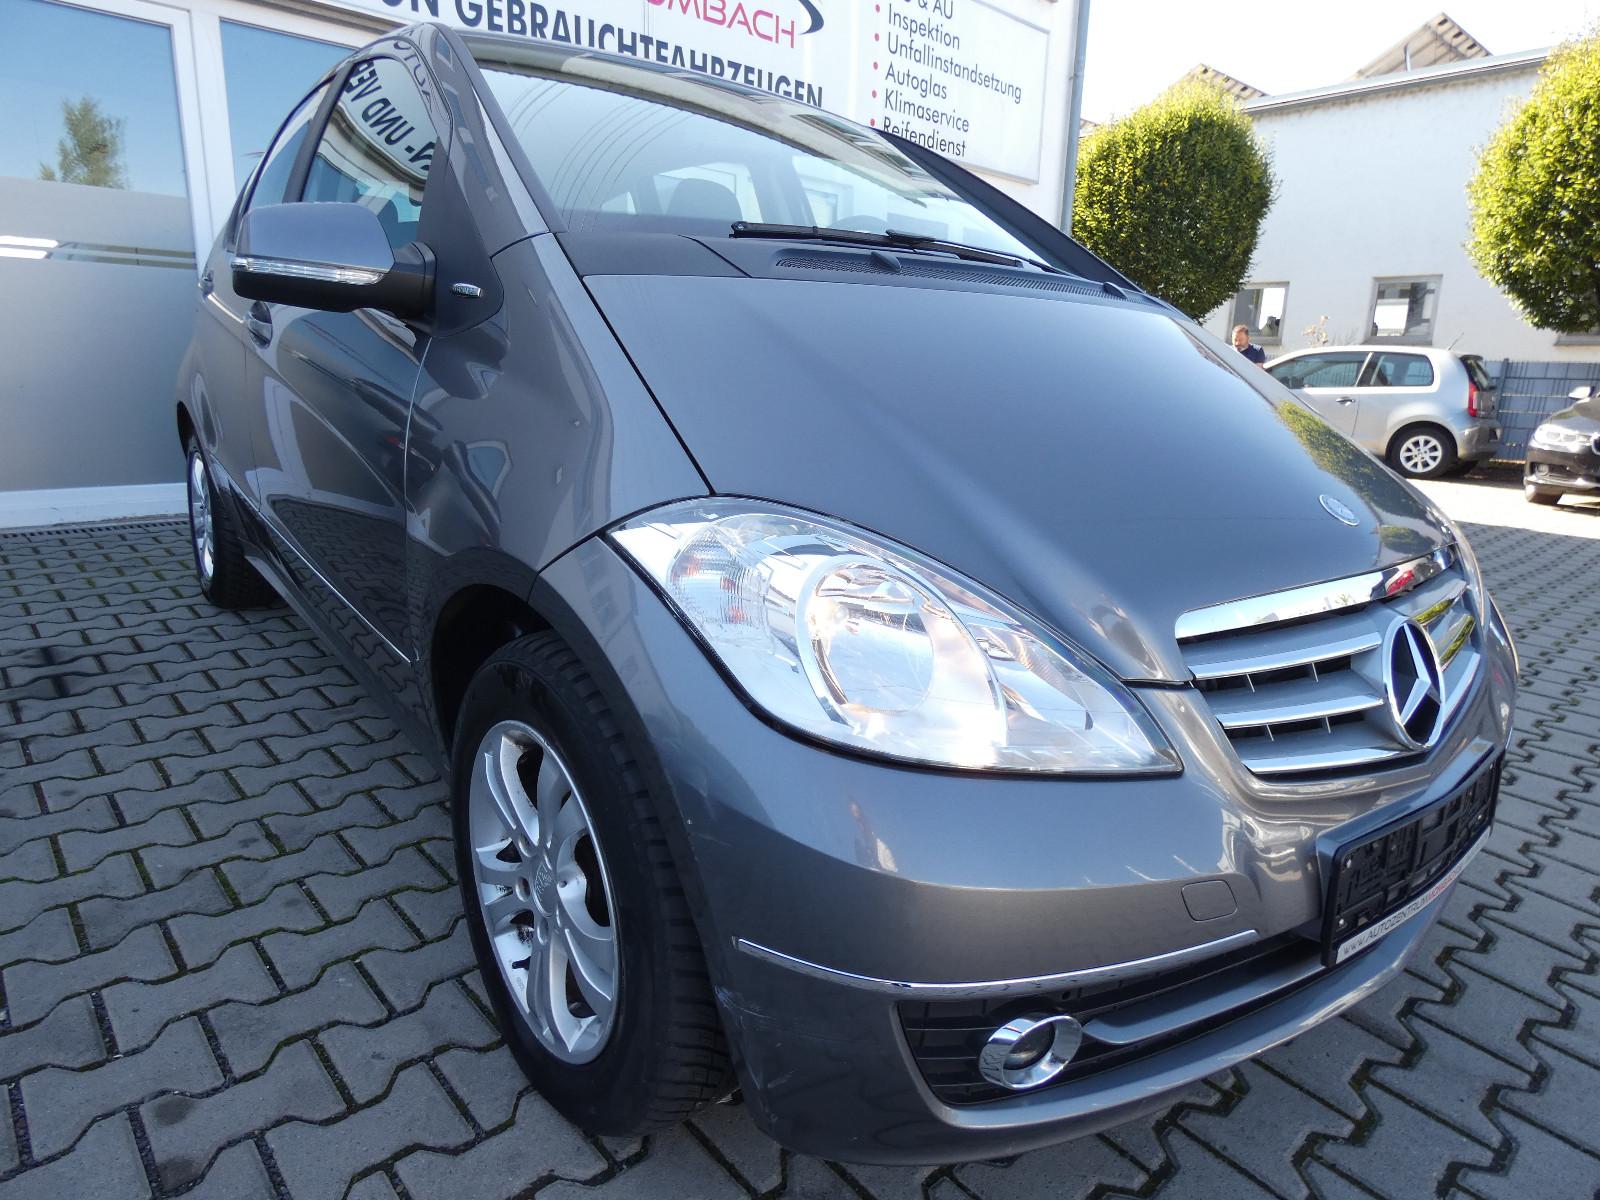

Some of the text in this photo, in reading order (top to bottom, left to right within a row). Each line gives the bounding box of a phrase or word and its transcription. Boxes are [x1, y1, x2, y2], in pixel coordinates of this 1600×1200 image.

[888, 4, 960, 50] Inspektion
[933, 0, 954, 19] AU
[885, 61, 948, 100] Autoglas
[887, 32, 1022, 104] Unfallinstandsetzung
[884, 88, 970, 133] Klimaservice
[883, 116, 966, 157] Reifendienst
